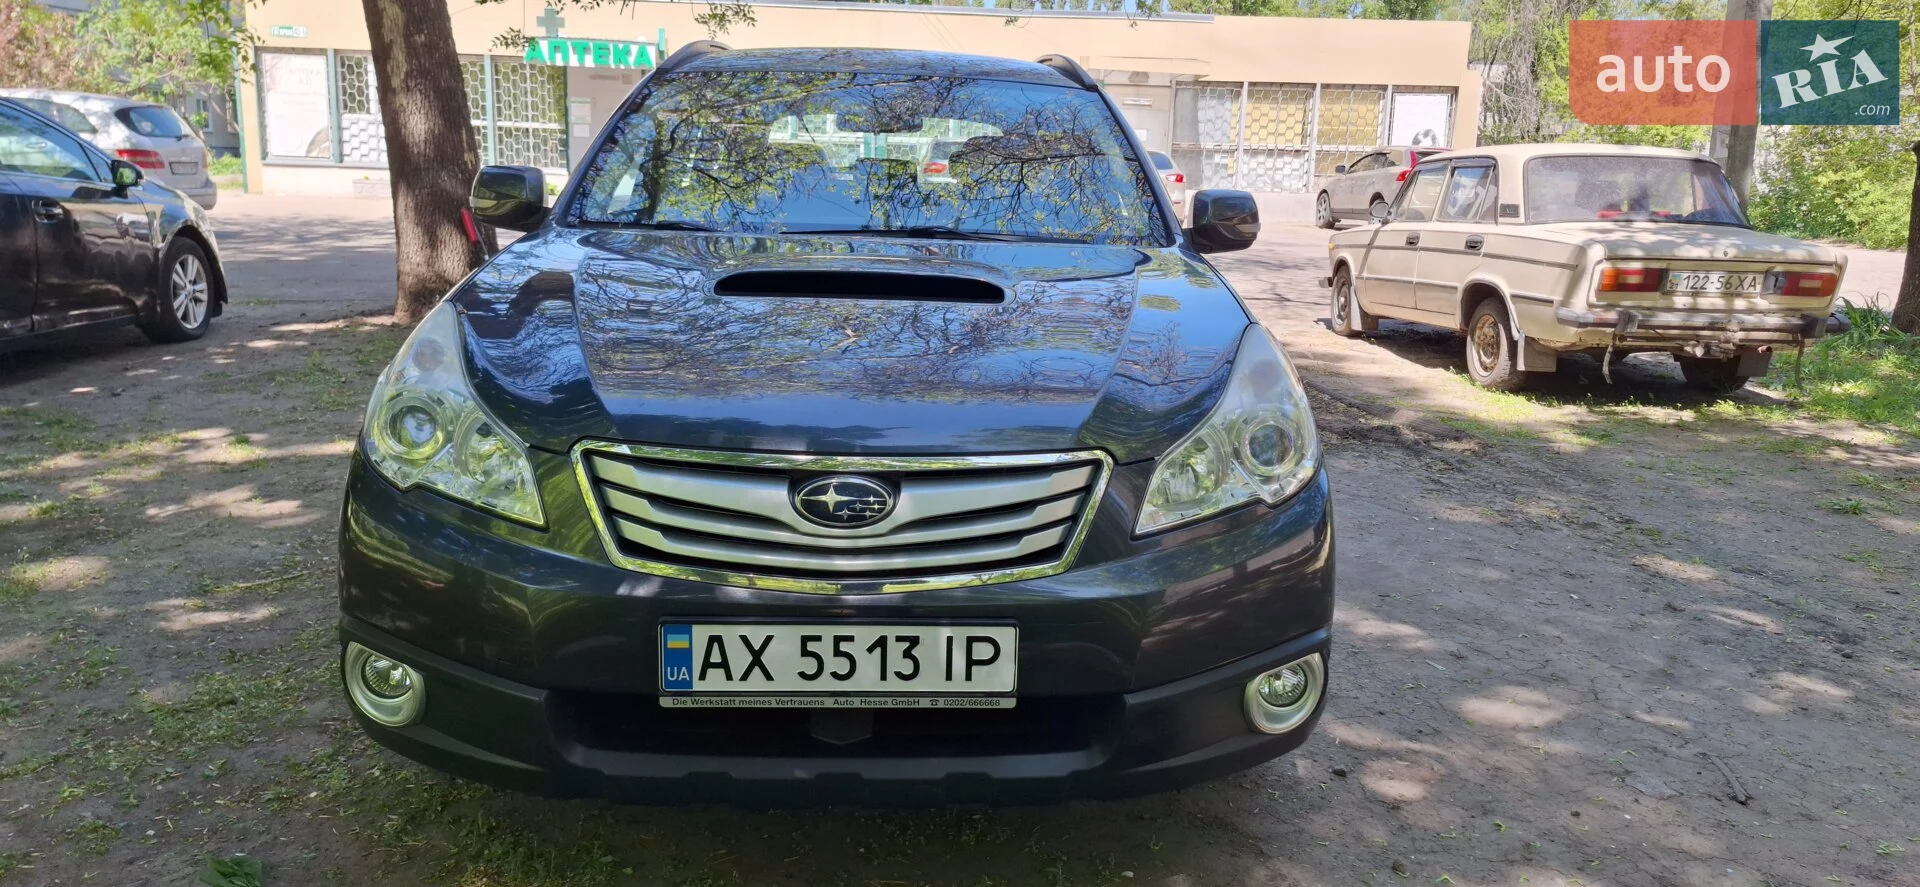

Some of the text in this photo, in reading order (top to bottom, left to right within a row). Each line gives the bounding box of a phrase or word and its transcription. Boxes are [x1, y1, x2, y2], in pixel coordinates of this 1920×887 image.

[523, 38, 654, 68] АПТЕКА
[698, 634, 1001, 682] AX 5513 IP
[667, 666, 690, 682] UA
[672, 698, 1000, 707] Die Werkstatt meines Vertrauens Auto Hesse GmbH 0202/666668
